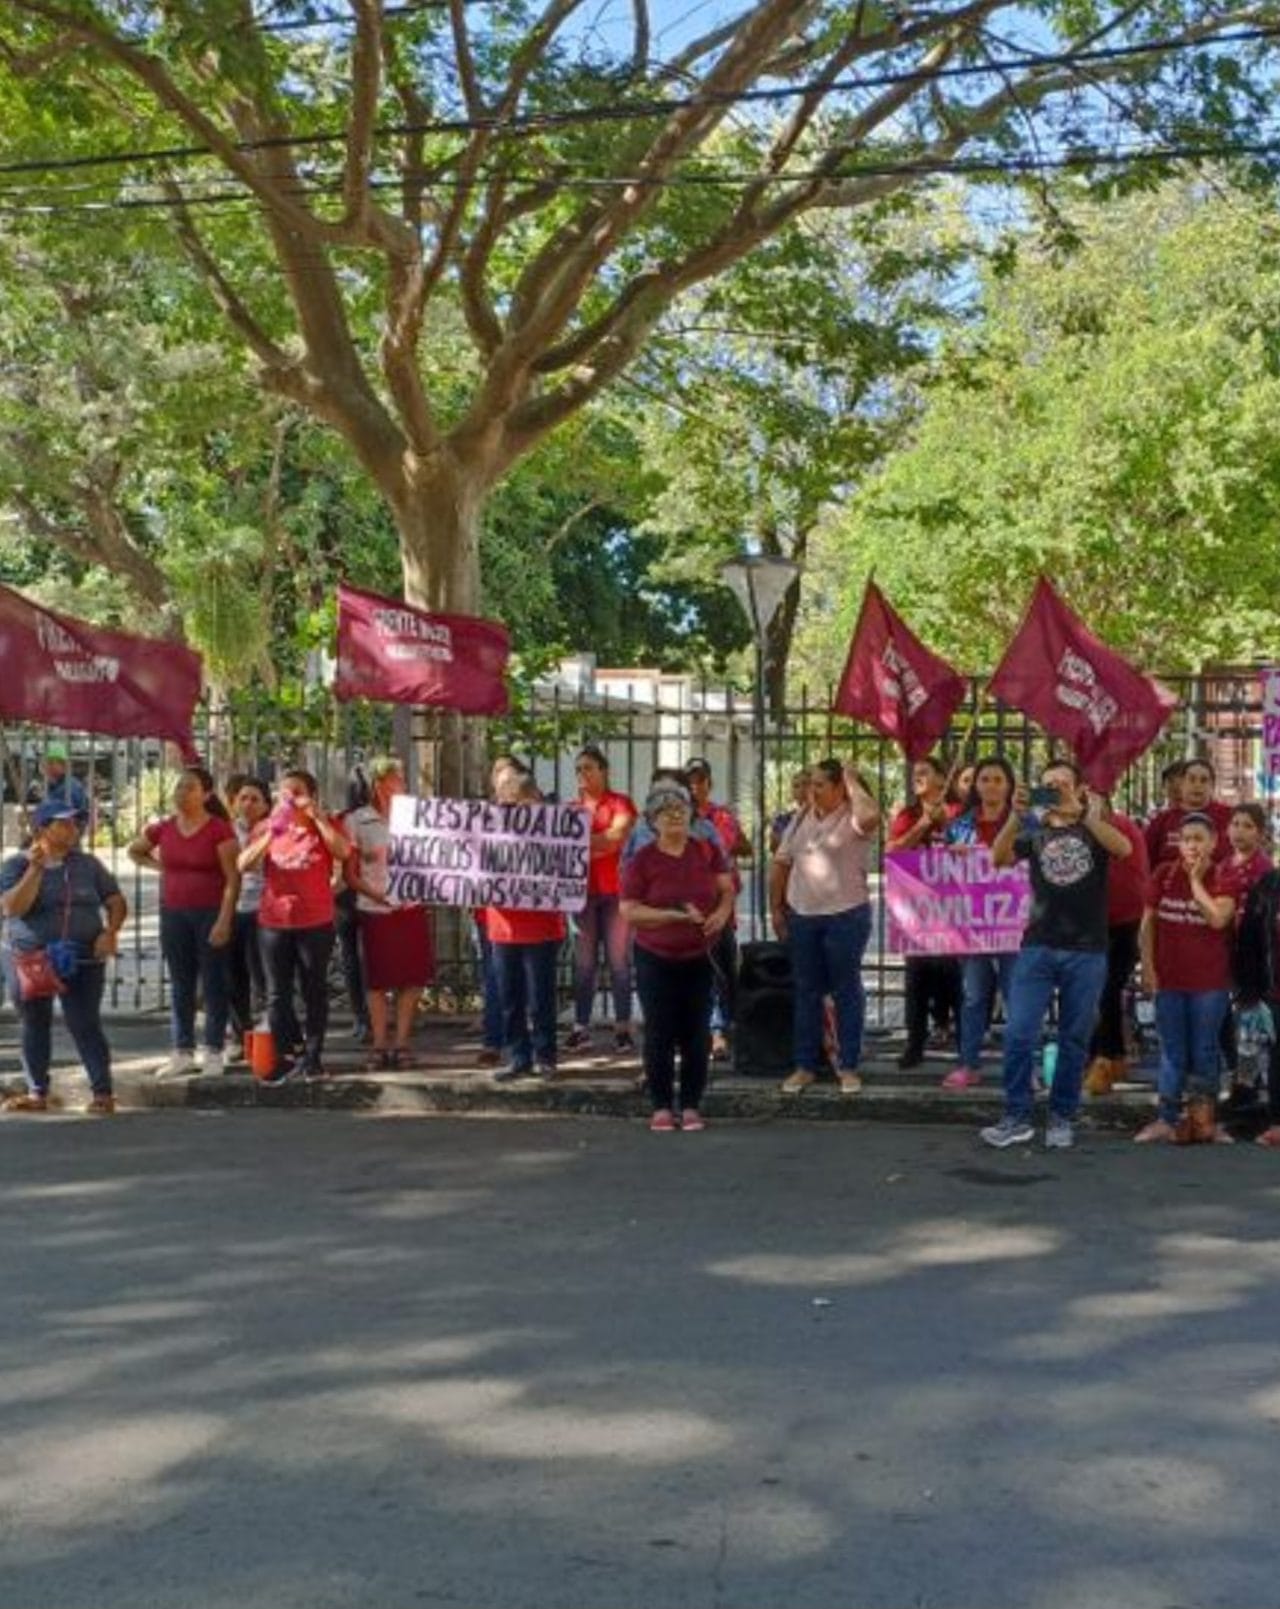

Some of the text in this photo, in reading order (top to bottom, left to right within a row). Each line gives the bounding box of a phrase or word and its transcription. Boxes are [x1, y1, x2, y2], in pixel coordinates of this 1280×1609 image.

[414, 799, 586, 840] RESPETO A LOS
[387, 834, 588, 879] DERECHOS INDIVIDUALES
